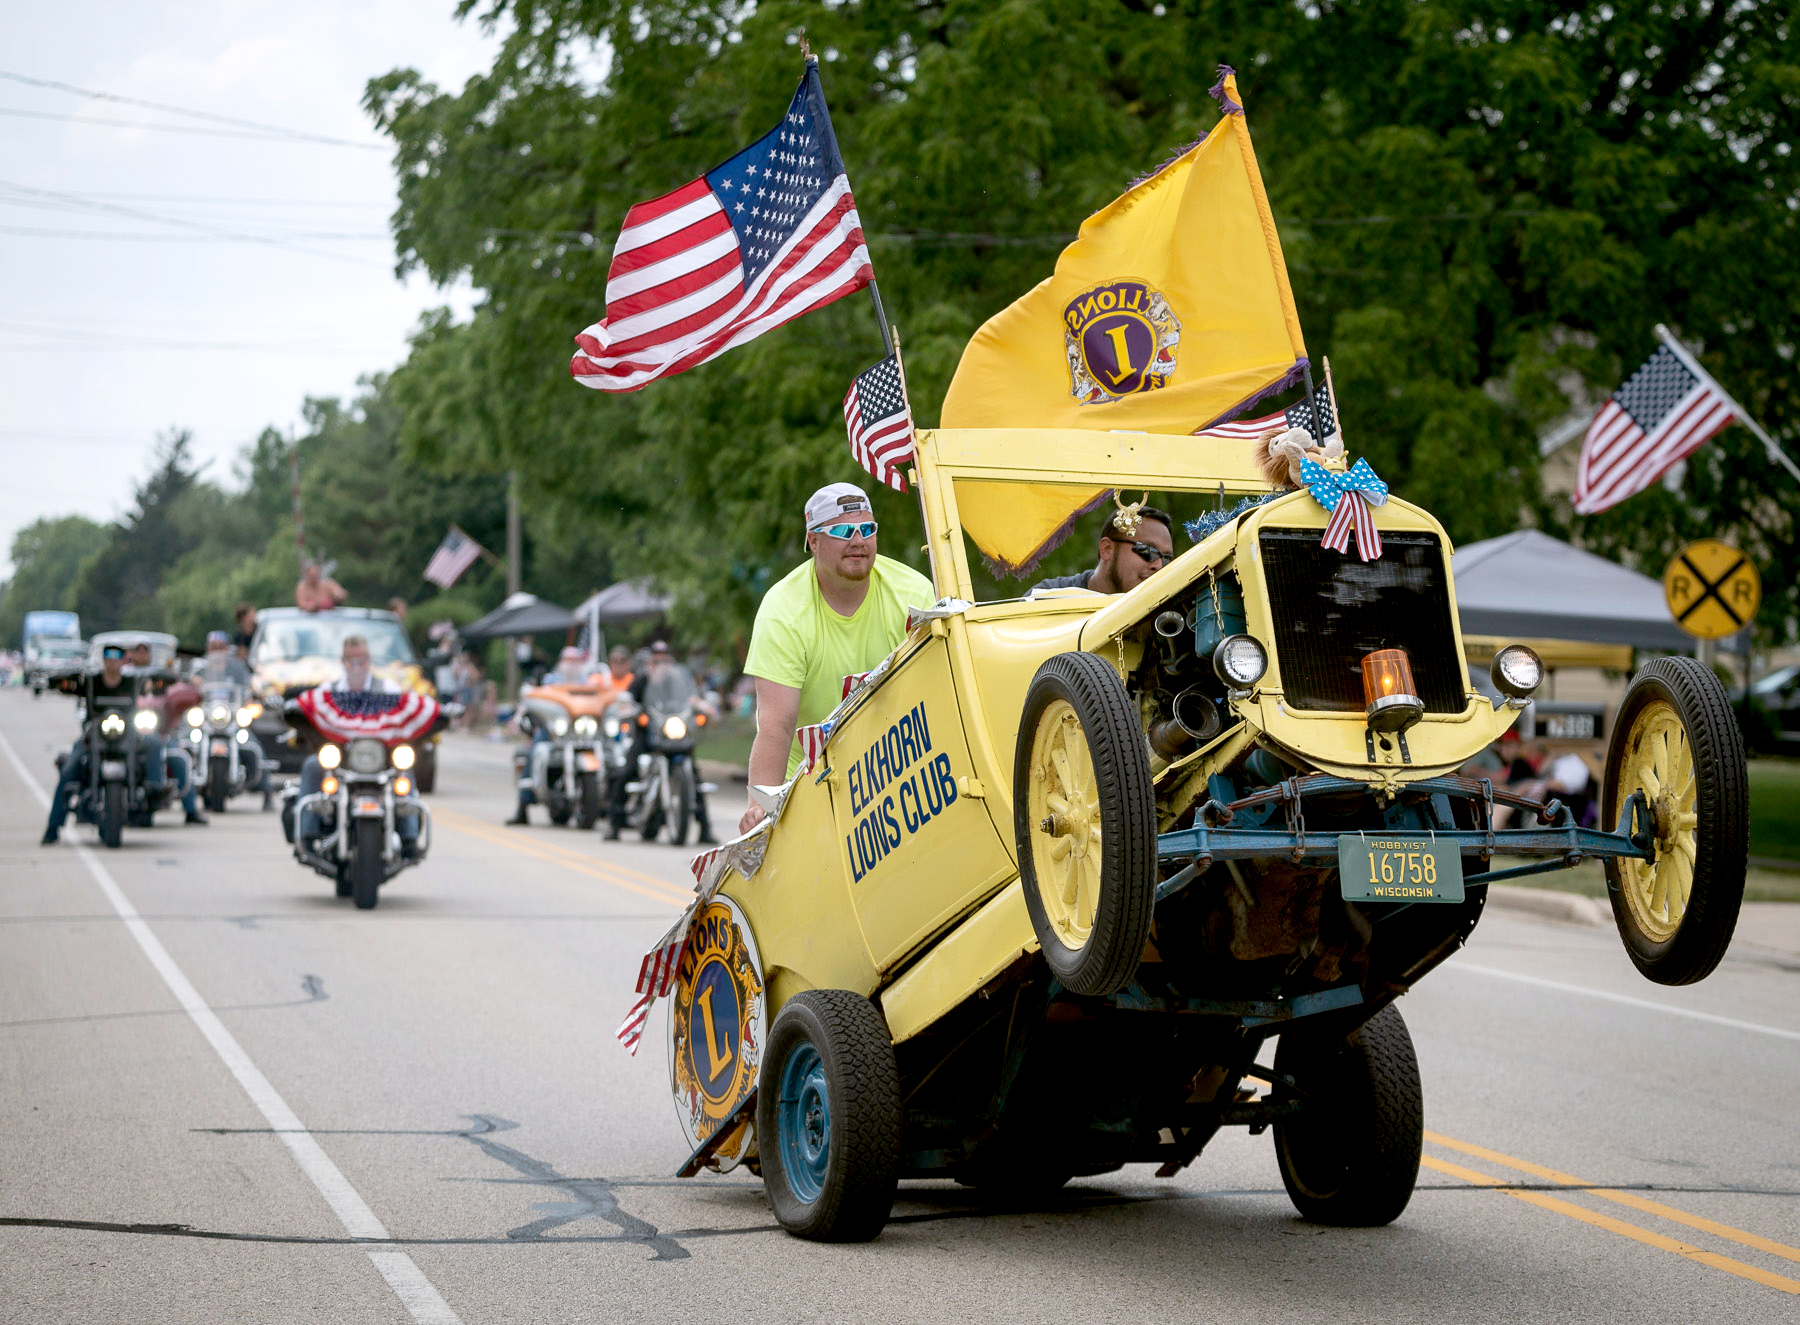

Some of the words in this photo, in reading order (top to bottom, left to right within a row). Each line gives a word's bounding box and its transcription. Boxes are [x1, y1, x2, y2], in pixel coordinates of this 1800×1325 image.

[1671, 575, 1691, 600] R
[1733, 579, 1753, 604] R
[847, 700, 933, 819] ELKHORN
[846, 795, 902, 885] LIONS
[899, 752, 959, 834] CLUB
[1371, 841, 1427, 851] HOBBYIST
[1368, 852, 1438, 885] 16758
[1374, 887, 1434, 898] WISCONSIN
